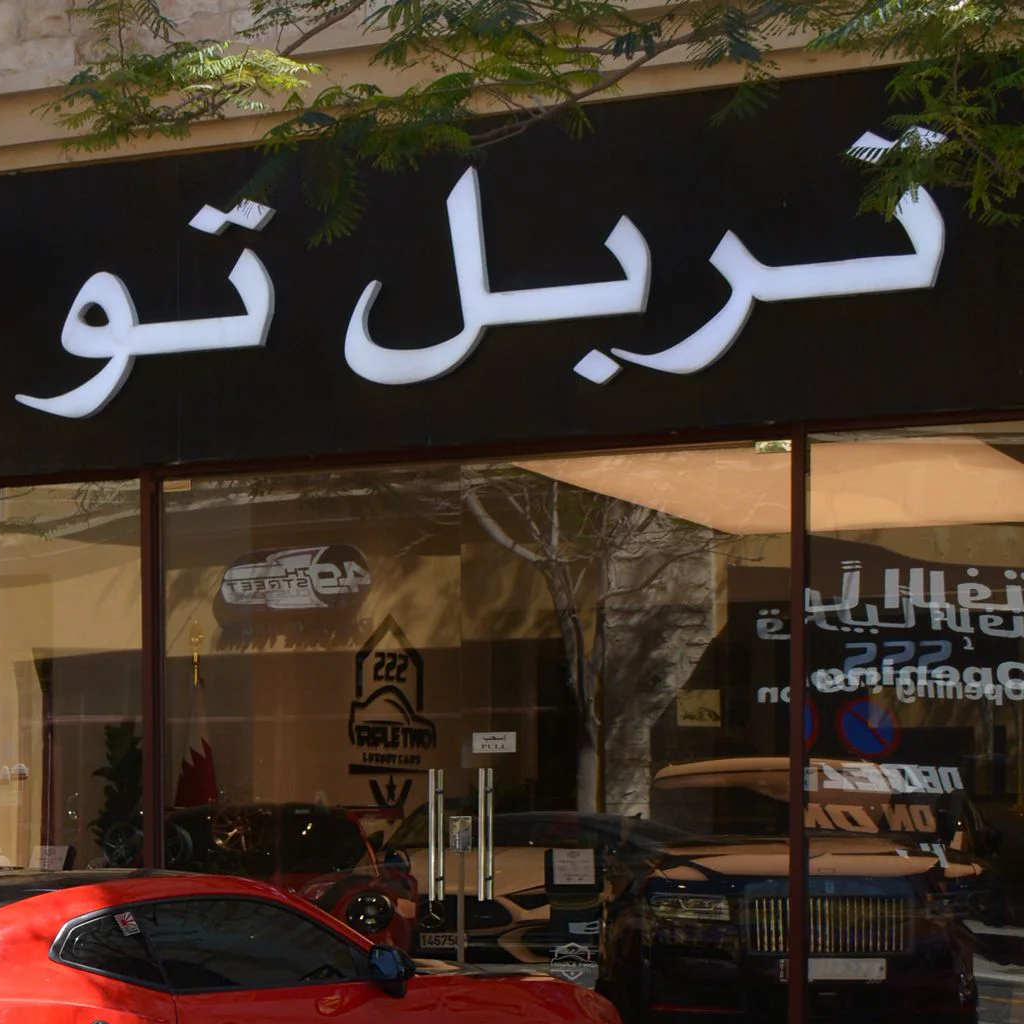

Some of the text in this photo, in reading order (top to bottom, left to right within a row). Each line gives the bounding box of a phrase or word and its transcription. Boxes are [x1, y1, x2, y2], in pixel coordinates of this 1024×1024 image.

[15, 198, 277, 420] تو
[373, 651, 409, 683] 222
[422, 934, 459, 946] 14675
